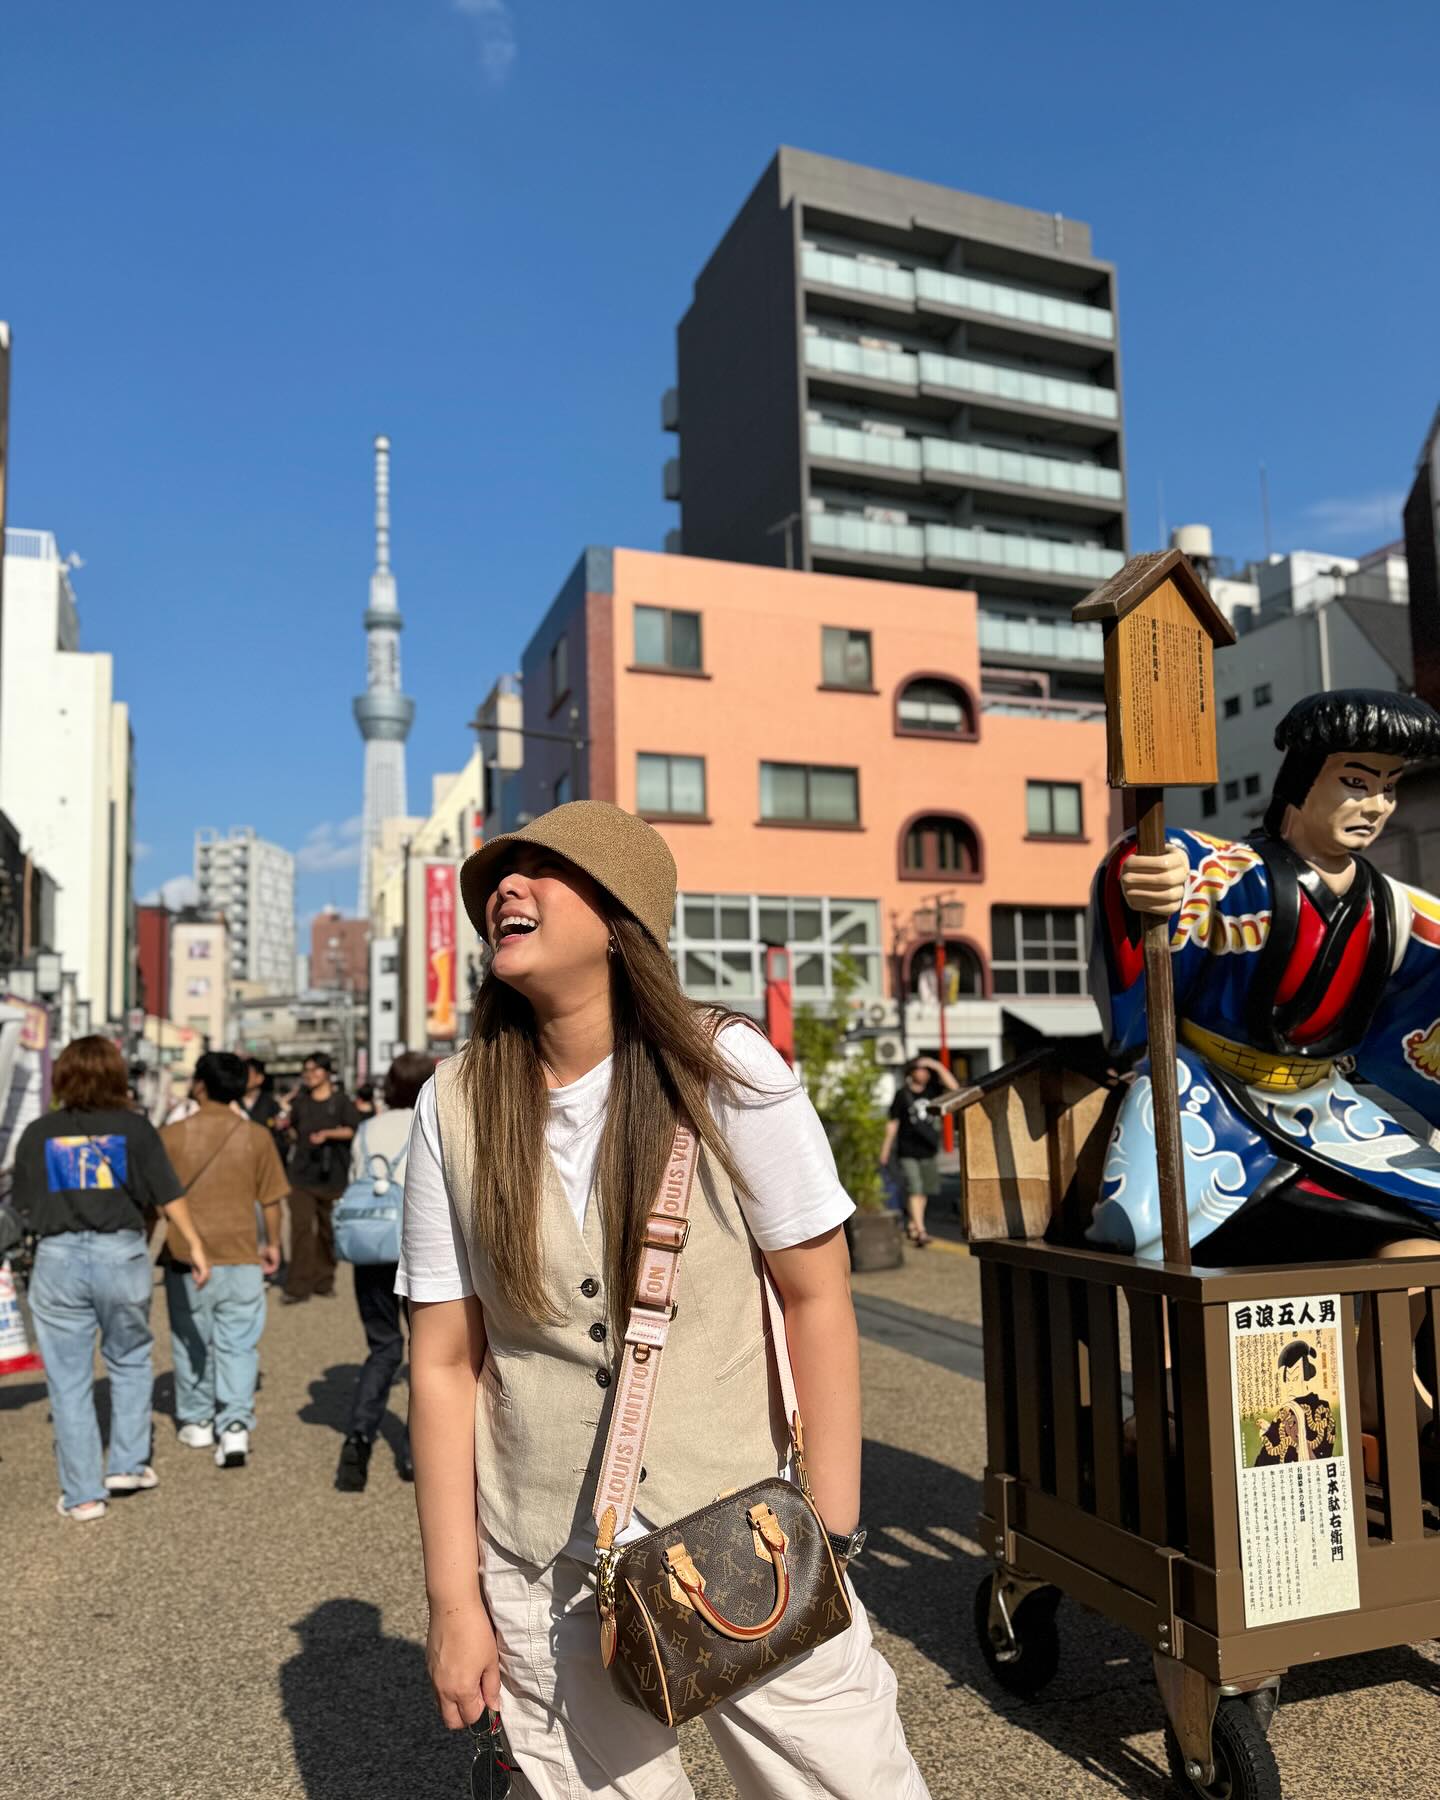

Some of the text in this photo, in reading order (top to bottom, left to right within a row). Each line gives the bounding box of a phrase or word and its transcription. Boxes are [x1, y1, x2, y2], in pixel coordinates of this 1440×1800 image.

[662, 1168, 685, 1215] OUIS
[1234, 1300, 1336, 1330] 白浪五人男
[606, 1359, 650, 1504] LOUIS VUITTO
[1325, 1462, 1344, 1563] 日本駄右衛門
